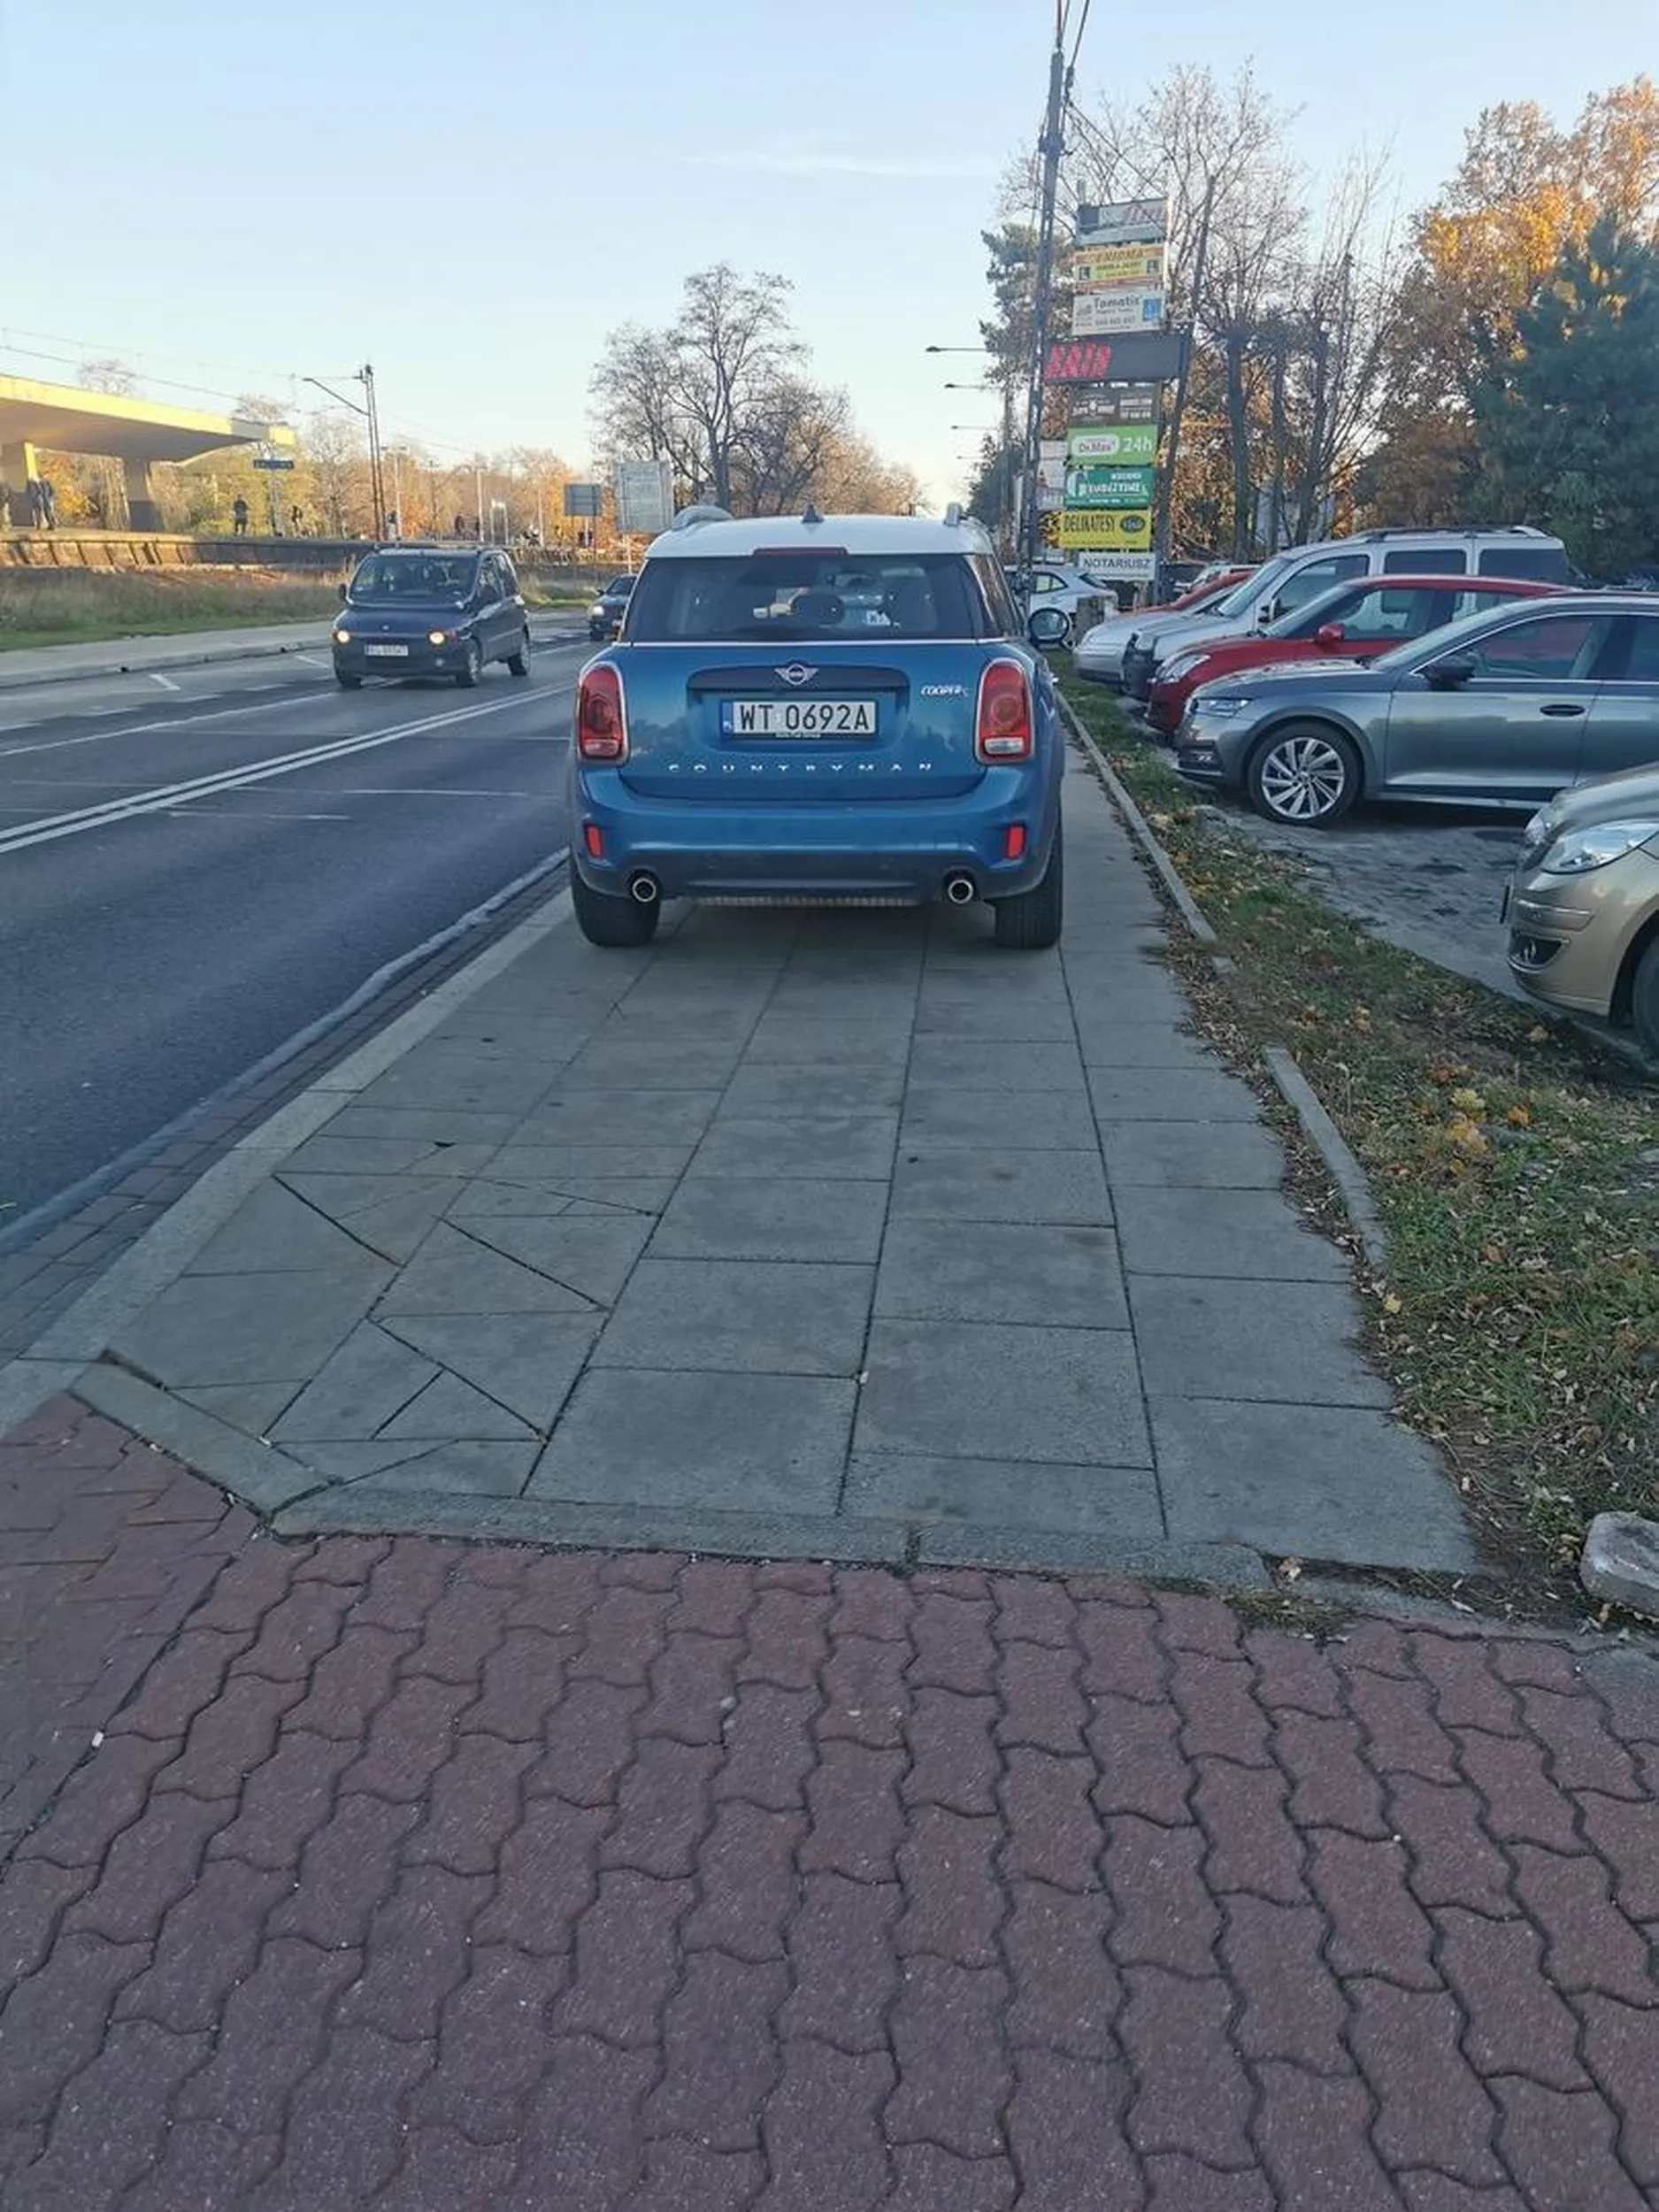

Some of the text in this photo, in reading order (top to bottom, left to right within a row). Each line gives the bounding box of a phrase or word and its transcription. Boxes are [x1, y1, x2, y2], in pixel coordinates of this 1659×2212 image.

[1121, 436, 1152, 452] 24h
[1064, 514, 1115, 533] DELIKATESY
[1083, 557, 1150, 569] NOTARIUSZ
[740, 703, 870, 731] WT 0692A
[669, 762, 932, 772] COUNTRYMAN
